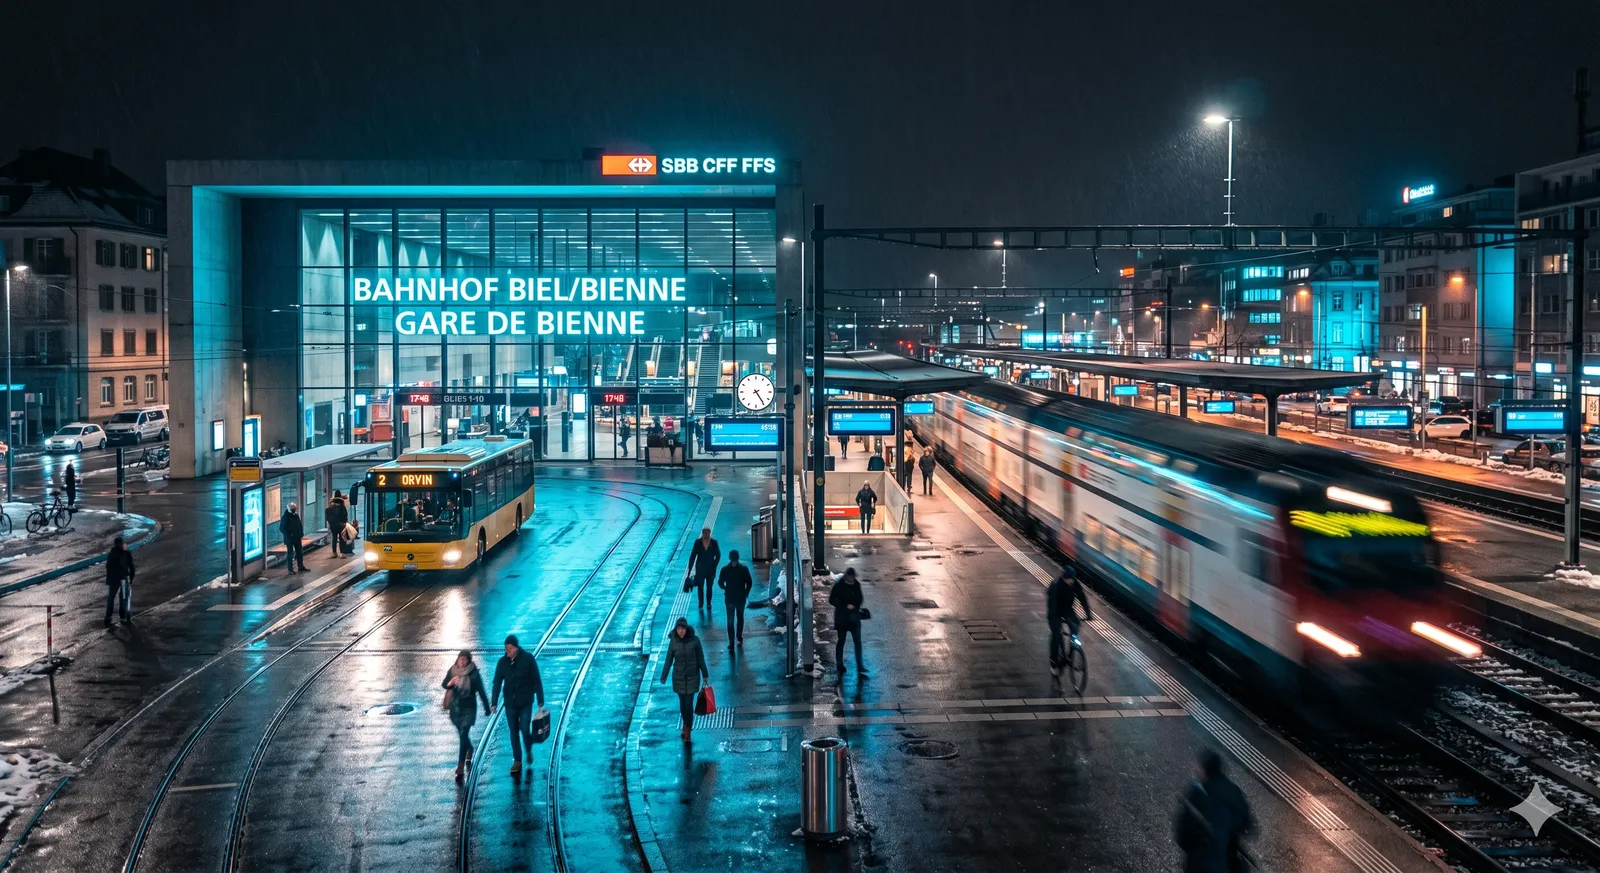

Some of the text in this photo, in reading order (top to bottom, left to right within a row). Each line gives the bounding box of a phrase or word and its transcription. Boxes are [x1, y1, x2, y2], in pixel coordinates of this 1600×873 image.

[661, 157, 776, 174] SBB CFF FFS
[353, 277, 687, 304] BAHNHOF BIEL/BIENNE
[394, 311, 645, 336] GARE DE BIENNE
[378, 474, 433, 486] 2 ORVIN
